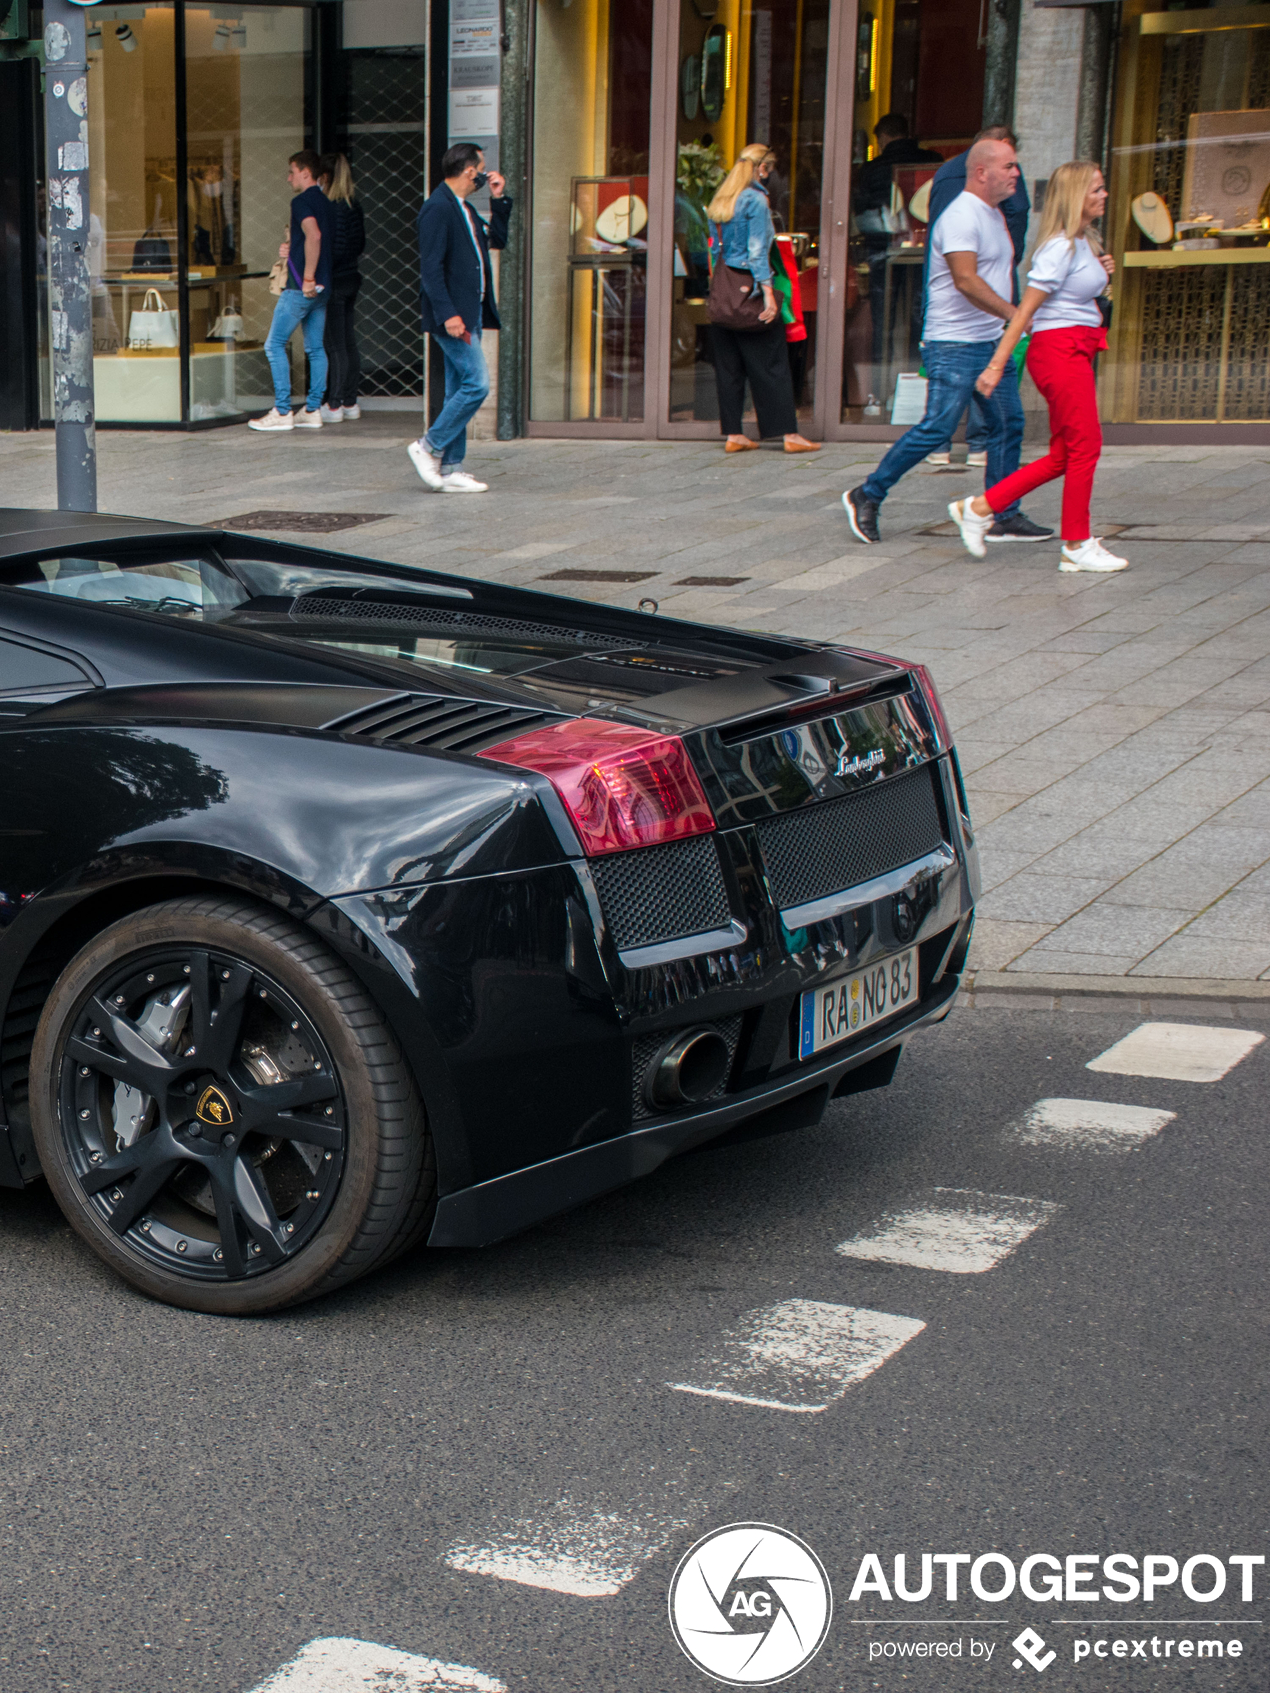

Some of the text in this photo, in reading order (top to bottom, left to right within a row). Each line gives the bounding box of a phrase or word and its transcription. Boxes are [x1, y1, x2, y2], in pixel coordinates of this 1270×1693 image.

[124, 336, 153, 352] PEPE
[833, 748, 887, 777] Lamborghini
[820, 984, 849, 1041] RA
[890, 952, 911, 1006] 83
